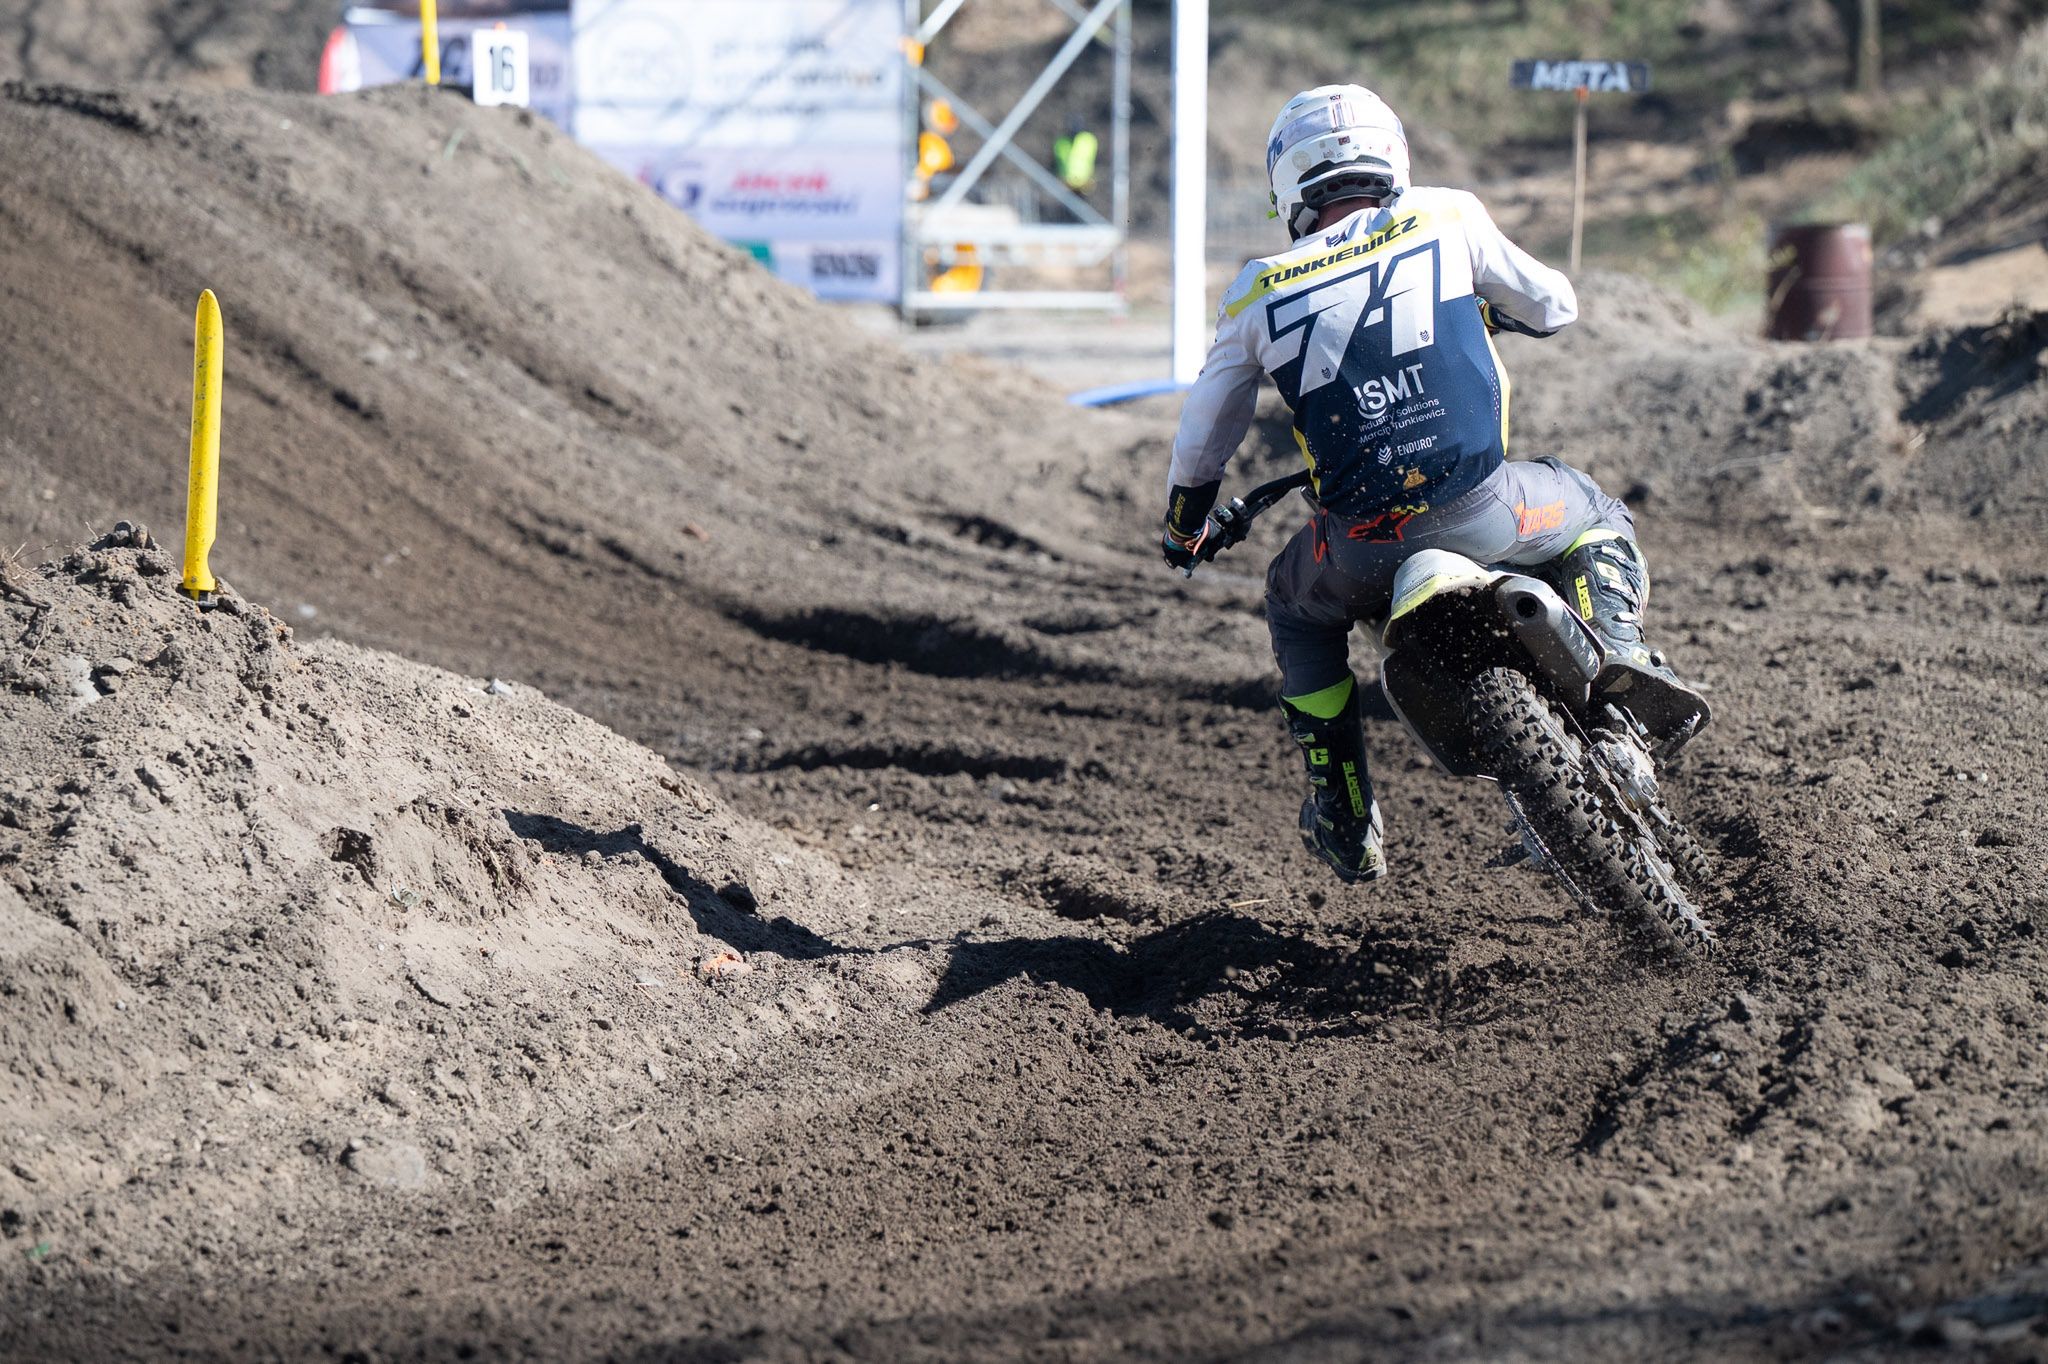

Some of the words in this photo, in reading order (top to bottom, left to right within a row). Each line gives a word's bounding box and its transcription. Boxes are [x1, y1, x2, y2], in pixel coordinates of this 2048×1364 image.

[489, 45, 515, 92] 16
[1531, 60, 1631, 93] META
[1260, 215, 1418, 288] TUNKIEWICZ
[1266, 238, 1440, 397] 71
[1353, 363, 1424, 411] ISMT
[1396, 398, 1440, 417] Solutions
[1360, 425, 1391, 444] Marcin
[1393, 408, 1446, 430] Tunkiewicz
